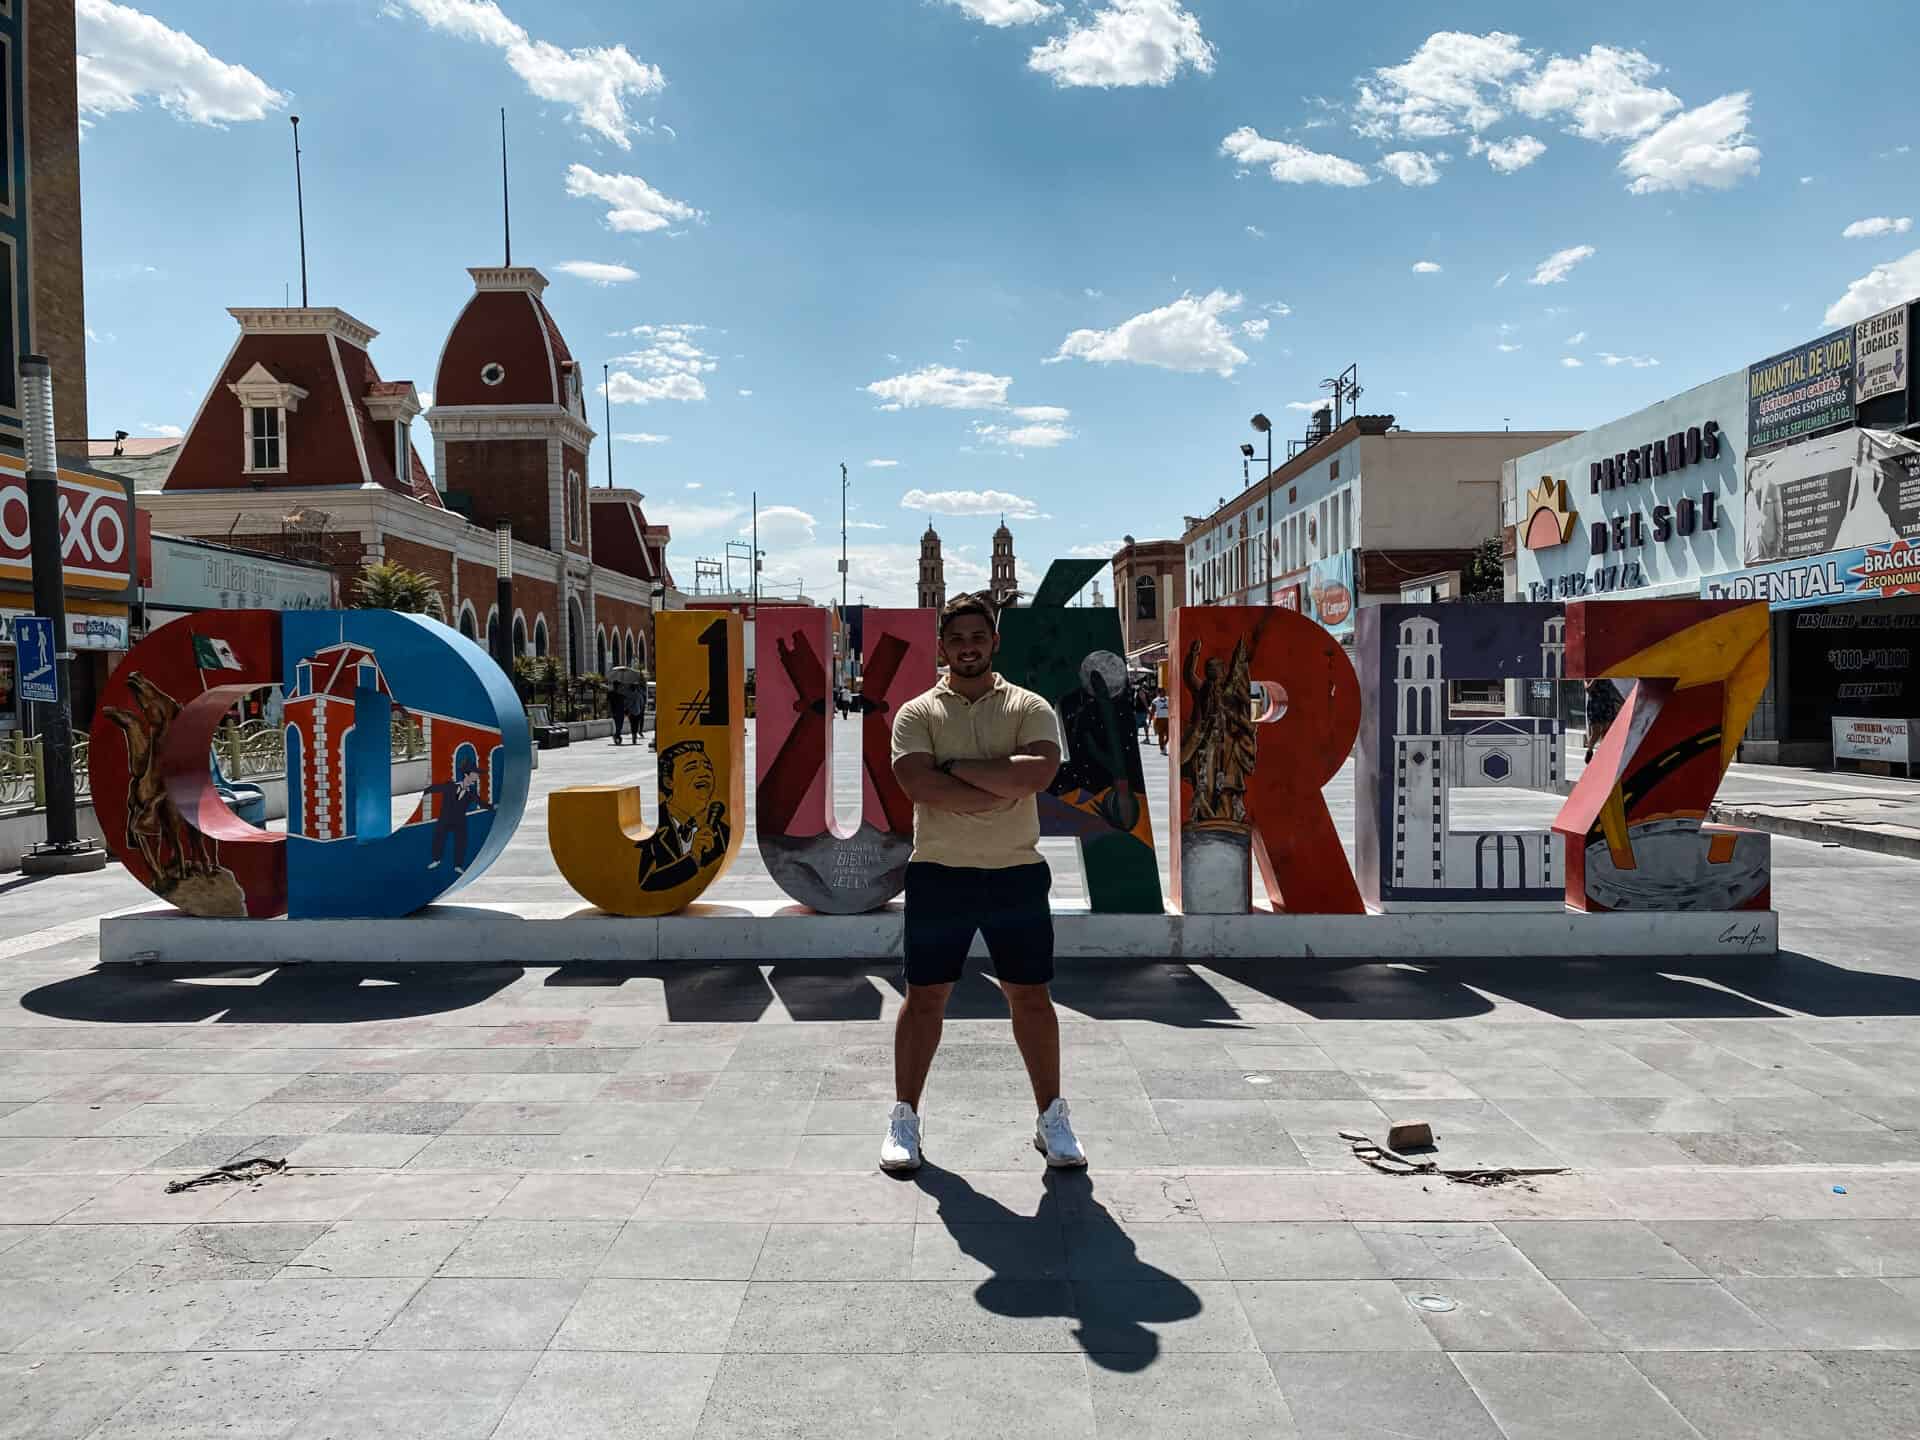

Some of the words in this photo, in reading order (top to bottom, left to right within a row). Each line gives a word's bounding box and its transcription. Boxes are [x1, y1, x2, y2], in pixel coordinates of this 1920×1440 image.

[1858, 324, 1868, 340] SE
[1871, 310, 1904, 336] RENTAN
[1862, 330, 1899, 356] LOCALES
[1752, 355, 1805, 397] MANANTIAL
[1809, 350, 1822, 374] DE
[1826, 337, 1851, 368] VIDA
[1760, 392, 1794, 414] LECTURA
[1795, 387, 1806, 401] DE
[1807, 376, 1841, 397] CARTAS
[1762, 405, 1801, 425] PRODUCTOS
[1803, 391, 1847, 414] ESOTERICOS
[1752, 430, 1771, 445] CALLE
[1790, 414, 1829, 435] SEPTIEMBRE
[1831, 405, 1850, 422] #105
[1591, 420, 1719, 494] PRESTAMOS
[0, 485, 124, 563] OXO
[1591, 512, 1644, 555] DEL
[1653, 491, 1719, 542] SOL
[1734, 562, 1845, 602] DENTAL
